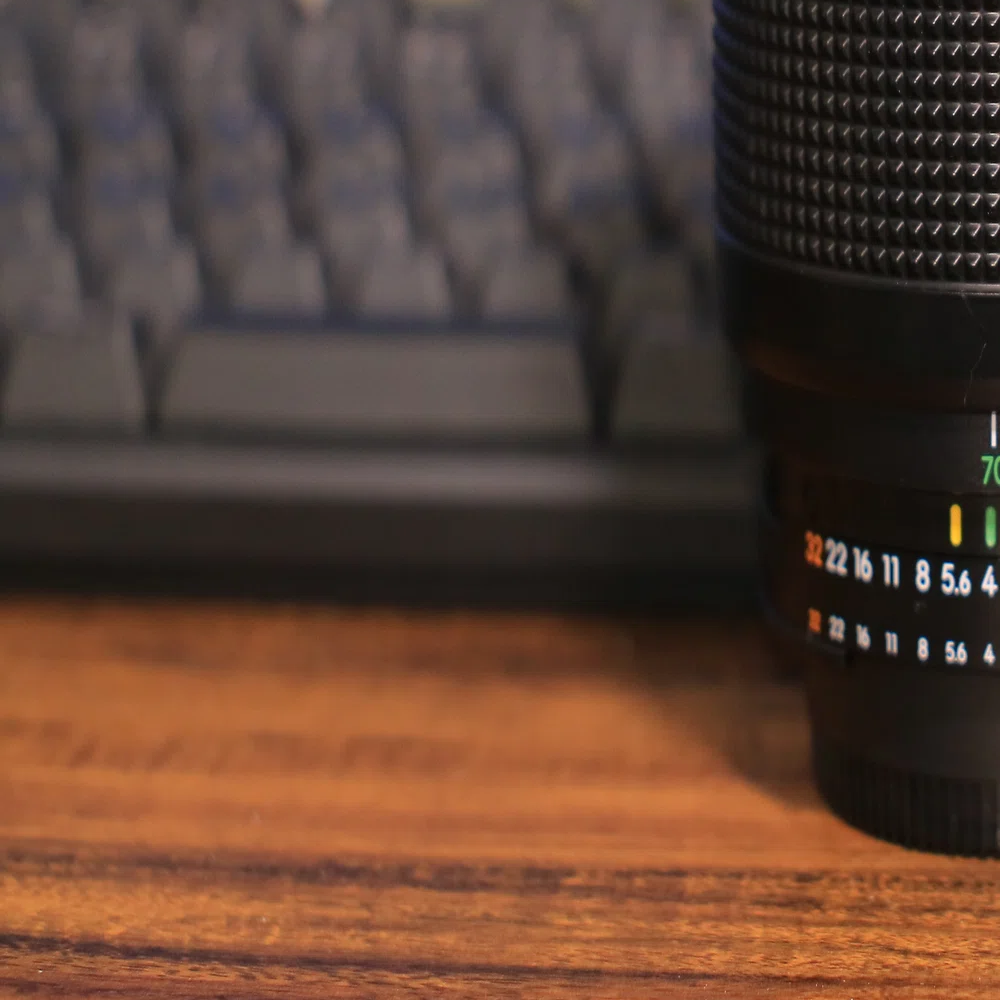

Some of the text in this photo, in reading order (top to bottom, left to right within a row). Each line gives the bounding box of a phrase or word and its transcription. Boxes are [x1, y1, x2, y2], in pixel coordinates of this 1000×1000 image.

[825, 538, 848, 576] 22
[853, 547, 874, 582] 16
[882, 553, 900, 587] 11
[915, 558, 931, 593] 8
[941, 561, 972, 597] 5.6
[980, 564, 999, 597] 4
[856, 624, 871, 649] 16
[885, 631, 898, 654] 11
[917, 636, 929, 661] 8
[945, 640, 968, 664] 5.6
[983, 643, 996, 665] 4
